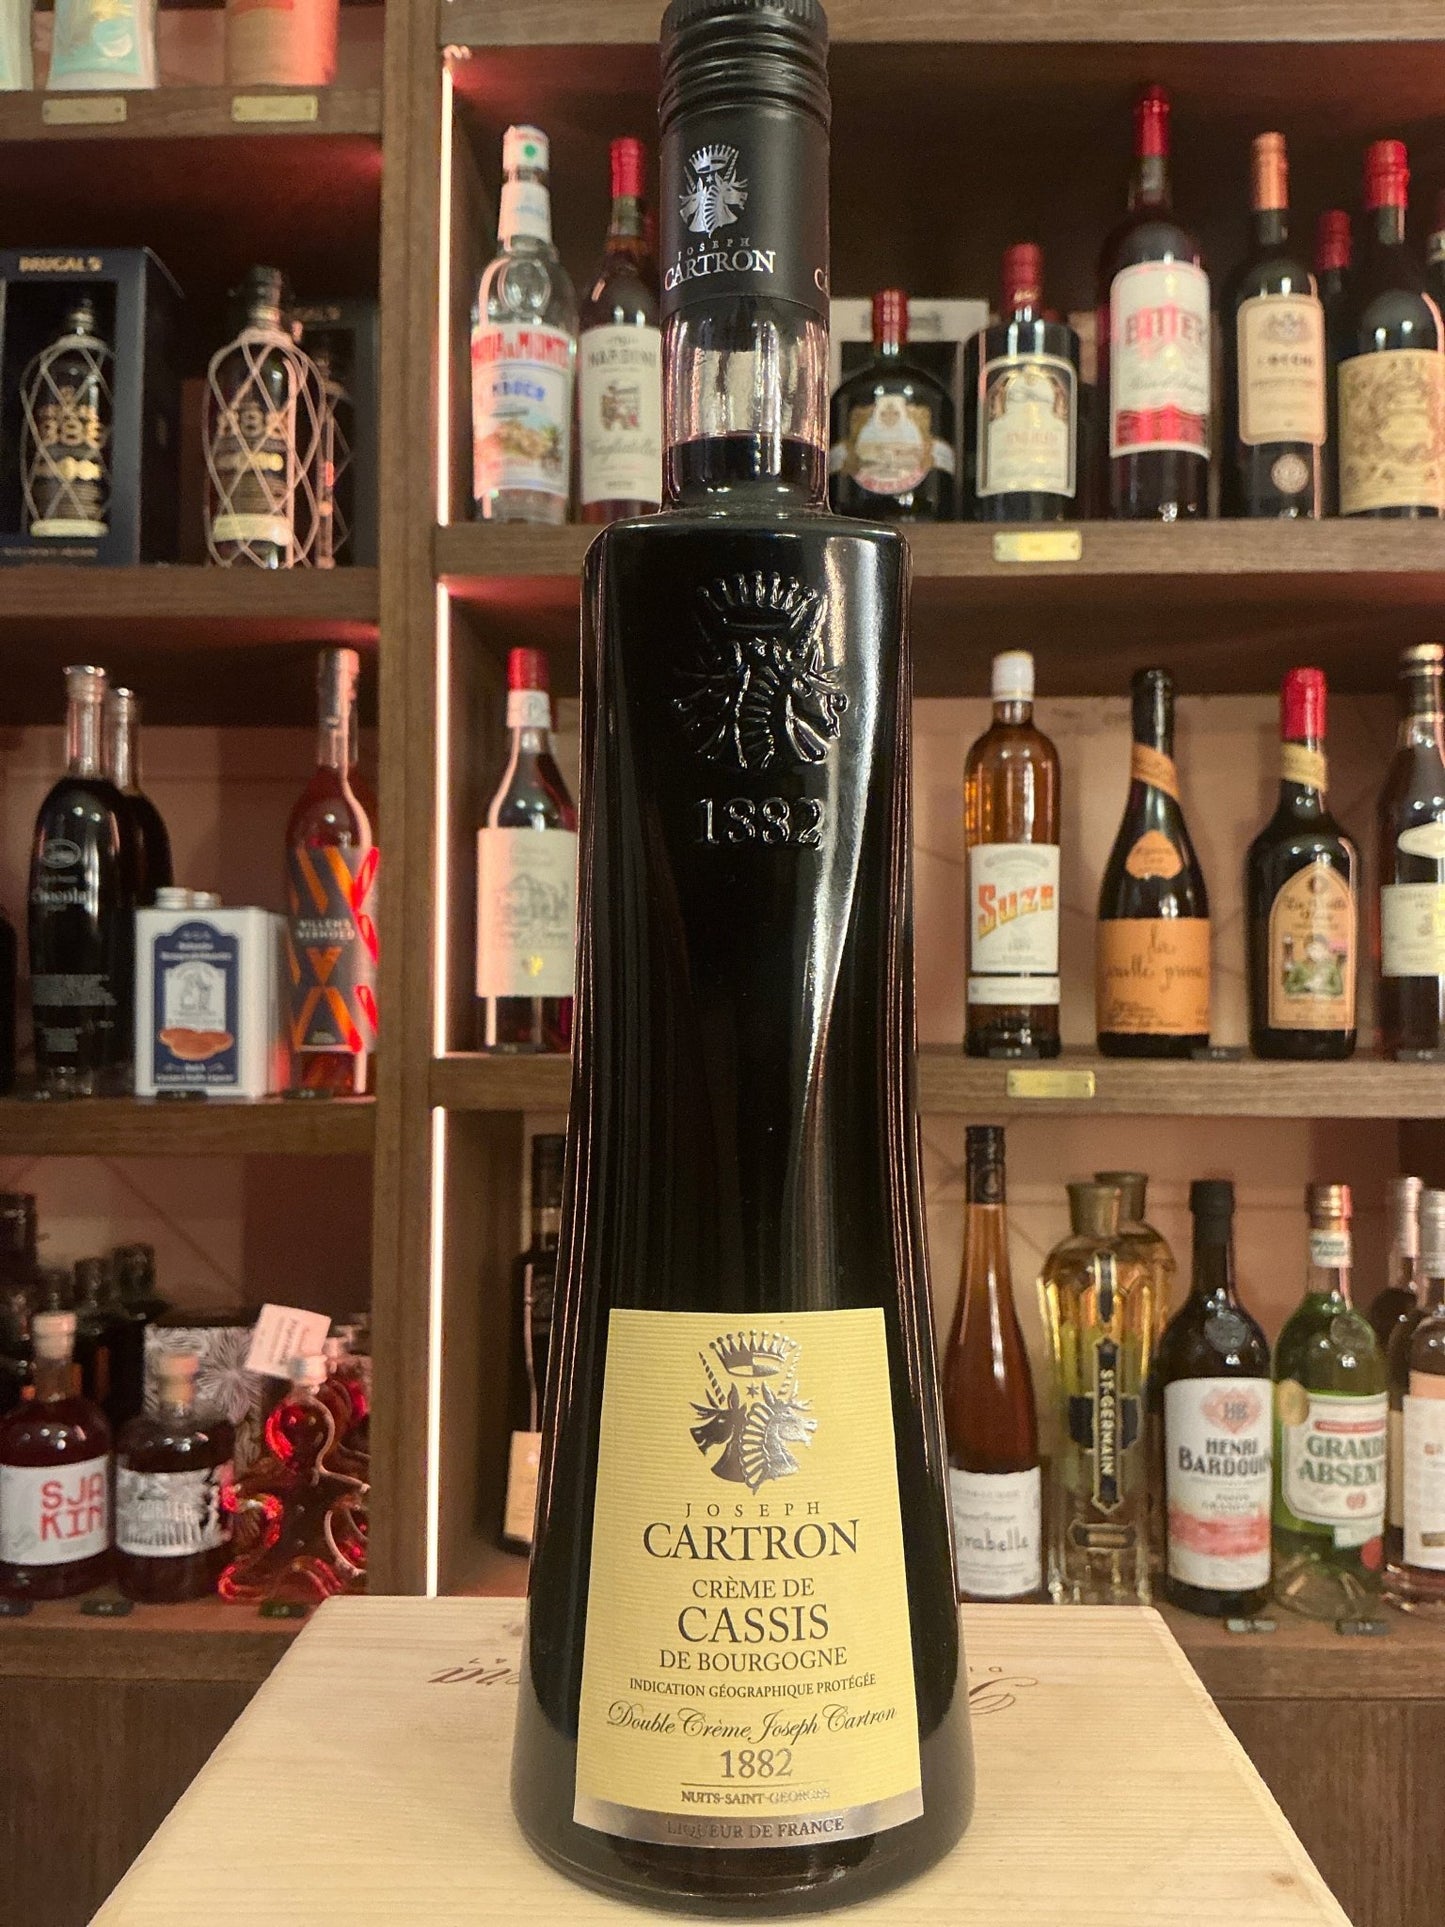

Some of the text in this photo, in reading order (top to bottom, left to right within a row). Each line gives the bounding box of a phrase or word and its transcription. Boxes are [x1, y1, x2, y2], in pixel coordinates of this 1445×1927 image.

[677, 237, 751, 260] JOSEPH
[664, 249, 777, 291] CARTRON
[697, 797, 823, 850] 1882
[1206, 1437, 1259, 1455] HENRI
[685, 1500, 822, 1518] JOSEPH
[642, 1519, 860, 1562] CARTRON
[692, 1576, 815, 1599] CRÈME DE
[678, 1603, 829, 1643] CASSIS
[659, 1646, 848, 1673] DE BOURGOGNE
[629, 1672, 877, 1699] INDICATION GÉOGRAPHIQUE PROTÉGÉE
[606, 1700, 676, 1734] Double
[749, 1709, 819, 1746] Joseph
[822, 1703, 897, 1732] Cartron
[719, 1748, 793, 1779] 1882
[666, 1816, 845, 1840] LIQUEUR DE FRANCE
